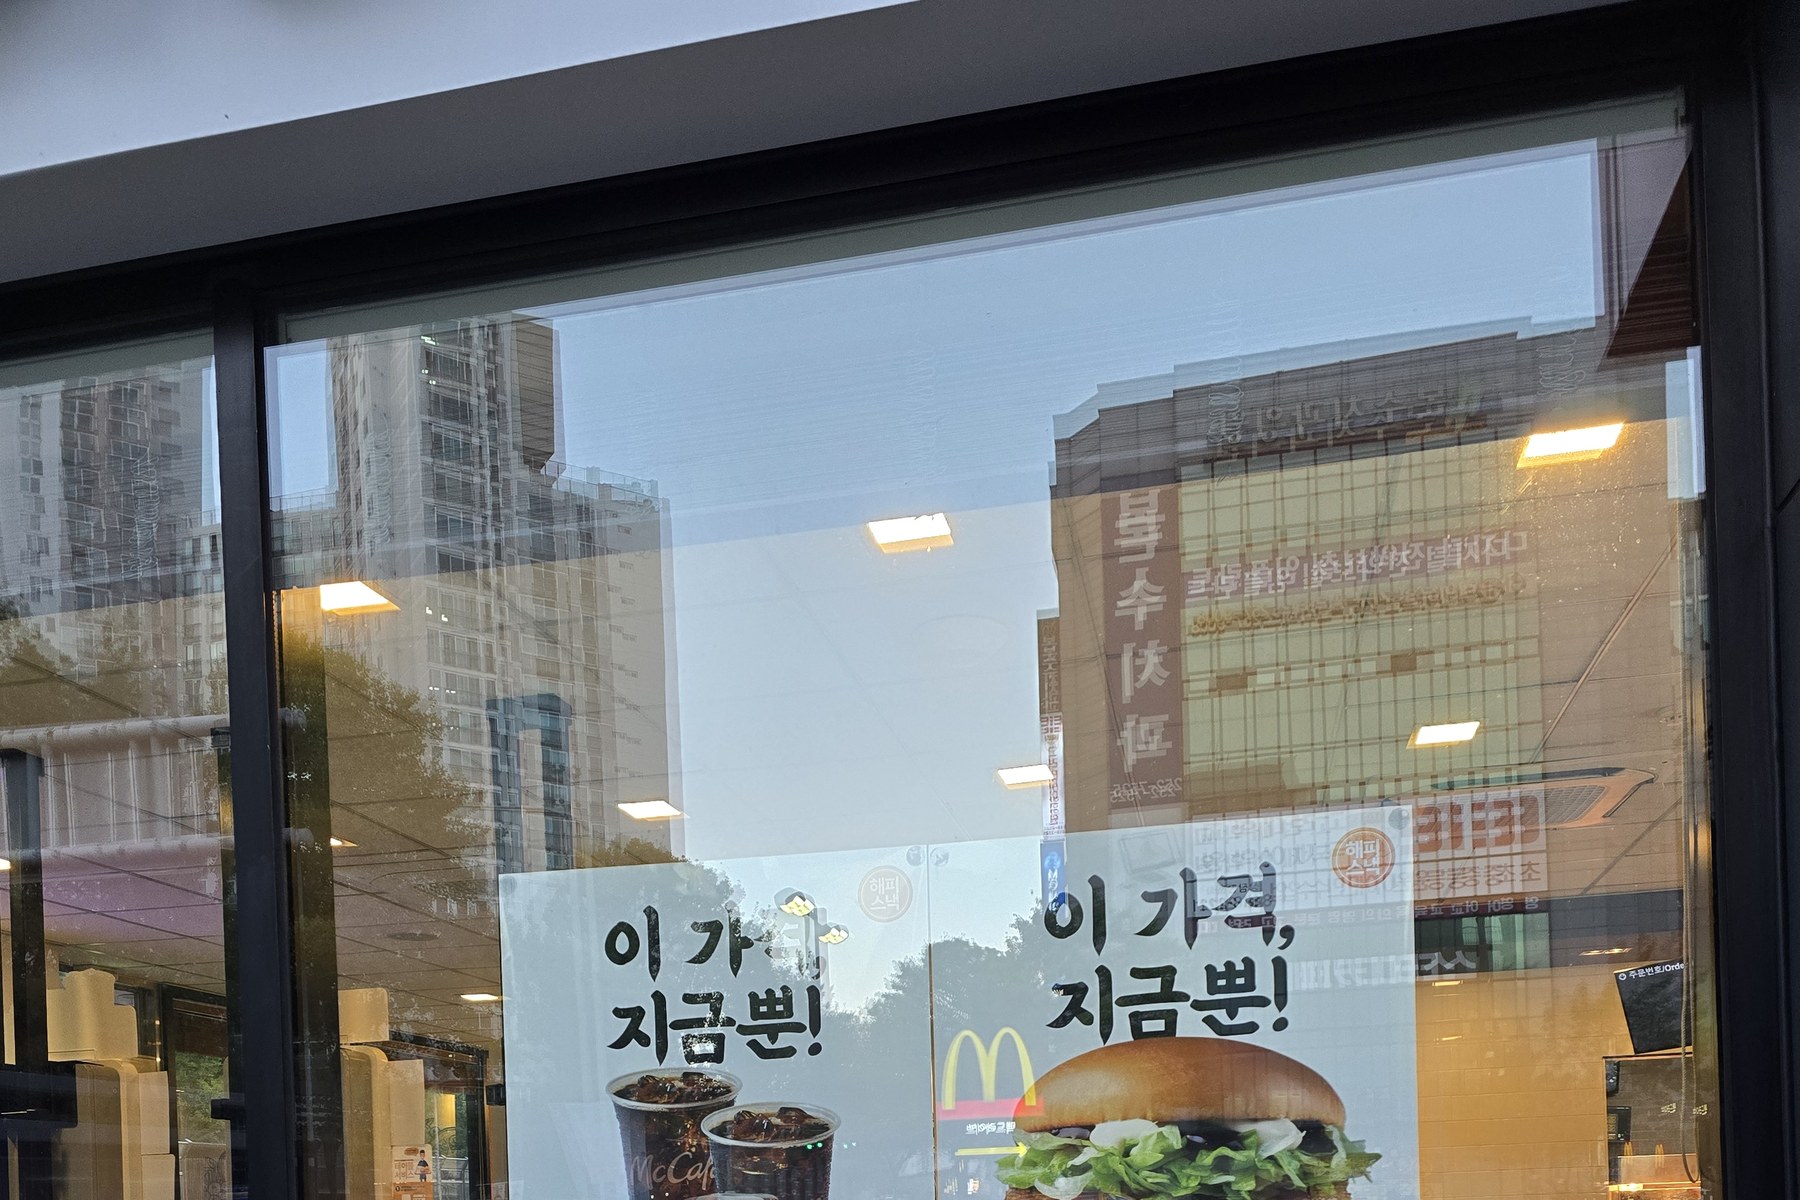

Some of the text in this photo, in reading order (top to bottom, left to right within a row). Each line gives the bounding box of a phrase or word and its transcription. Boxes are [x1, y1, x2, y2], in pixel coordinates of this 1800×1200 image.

[1345, 838, 1380, 858] 해피
[1345, 857, 1380, 877] 스낵
[868, 876, 900, 895] 해피
[870, 895, 900, 911] 스낵
[1044, 874, 1107, 956] 이
[1135, 861, 1295, 951] 가격,
[604, 905, 661, 982] 이
[1045, 955, 1290, 1045] 지금뿐!
[606, 984, 823, 1066] 지금뿐!
